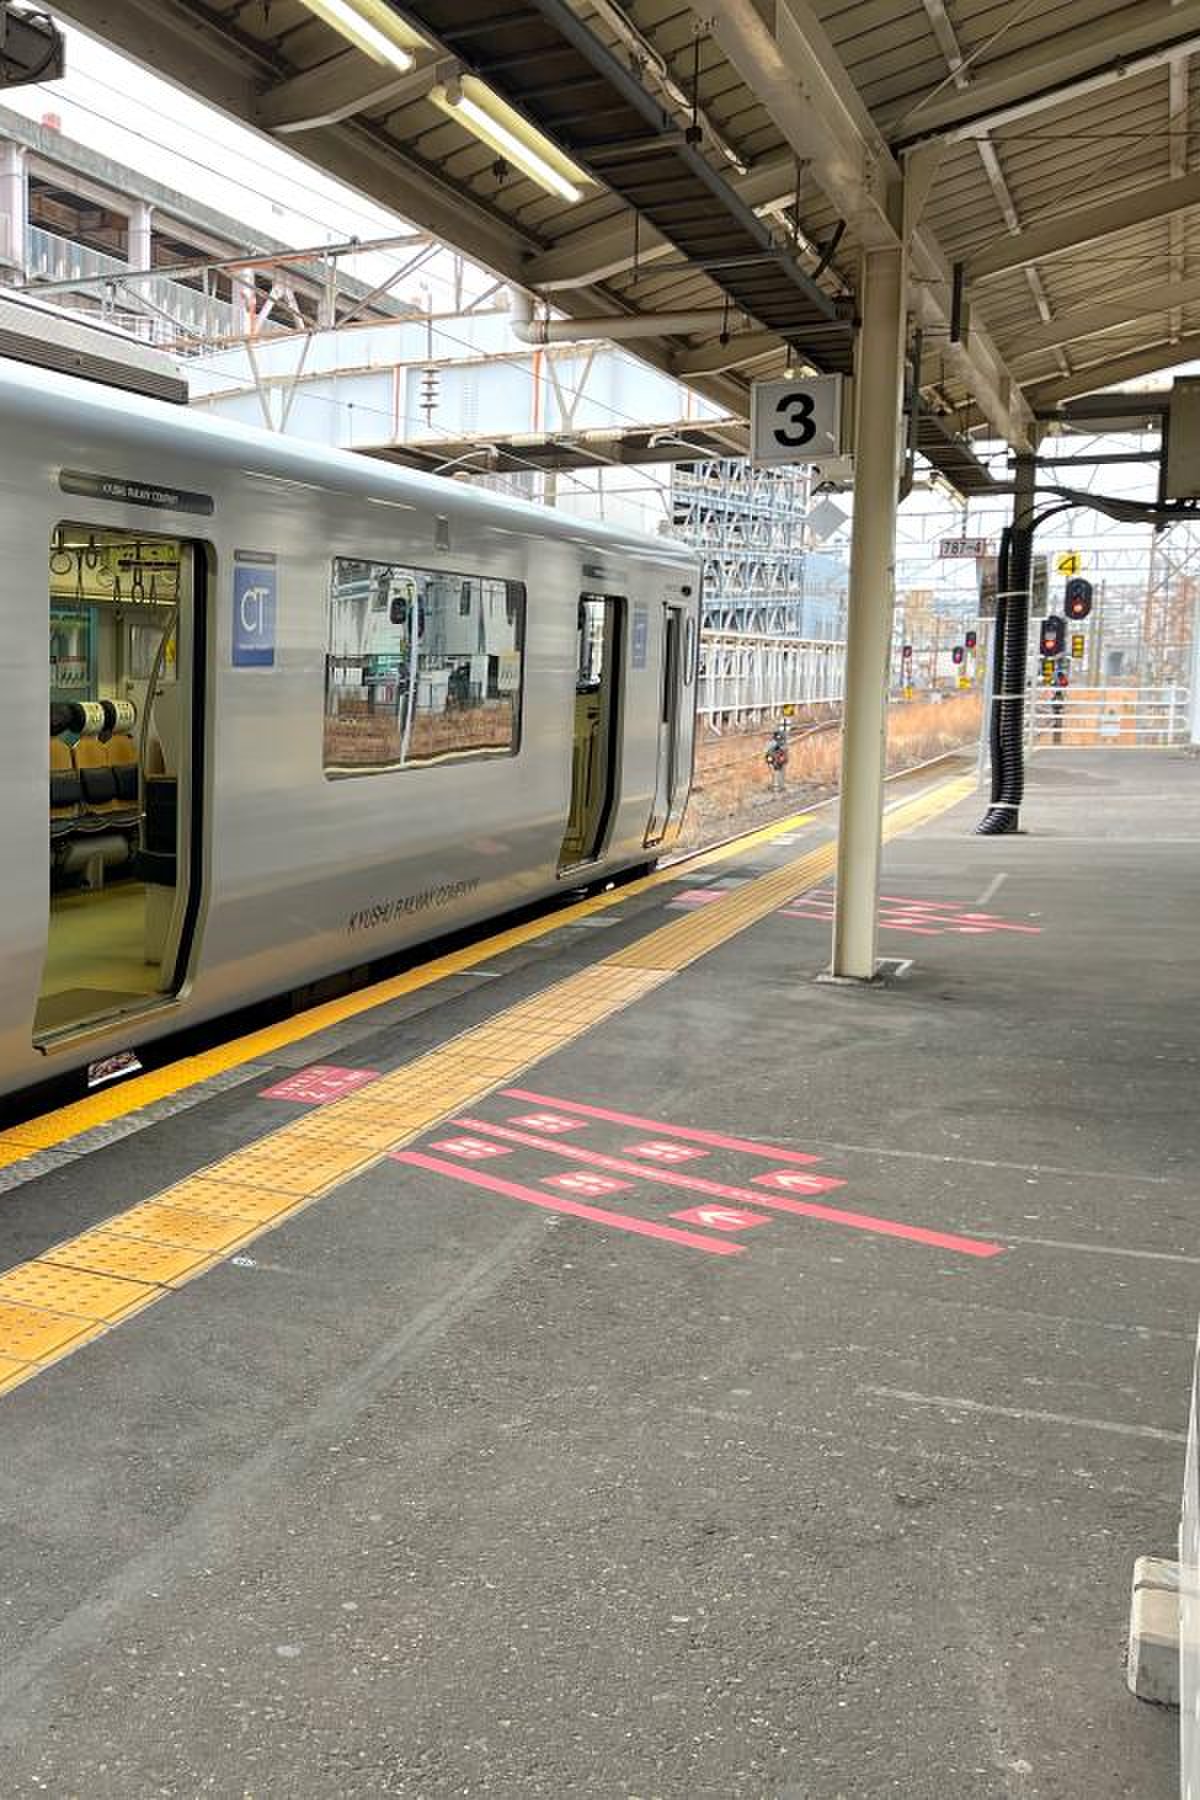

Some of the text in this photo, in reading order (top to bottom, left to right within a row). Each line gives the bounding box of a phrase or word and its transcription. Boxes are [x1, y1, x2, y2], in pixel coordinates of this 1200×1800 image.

[774, 393, 816, 447] 3
[1058, 556, 1076, 574] 4
[240, 587, 270, 635] CT
